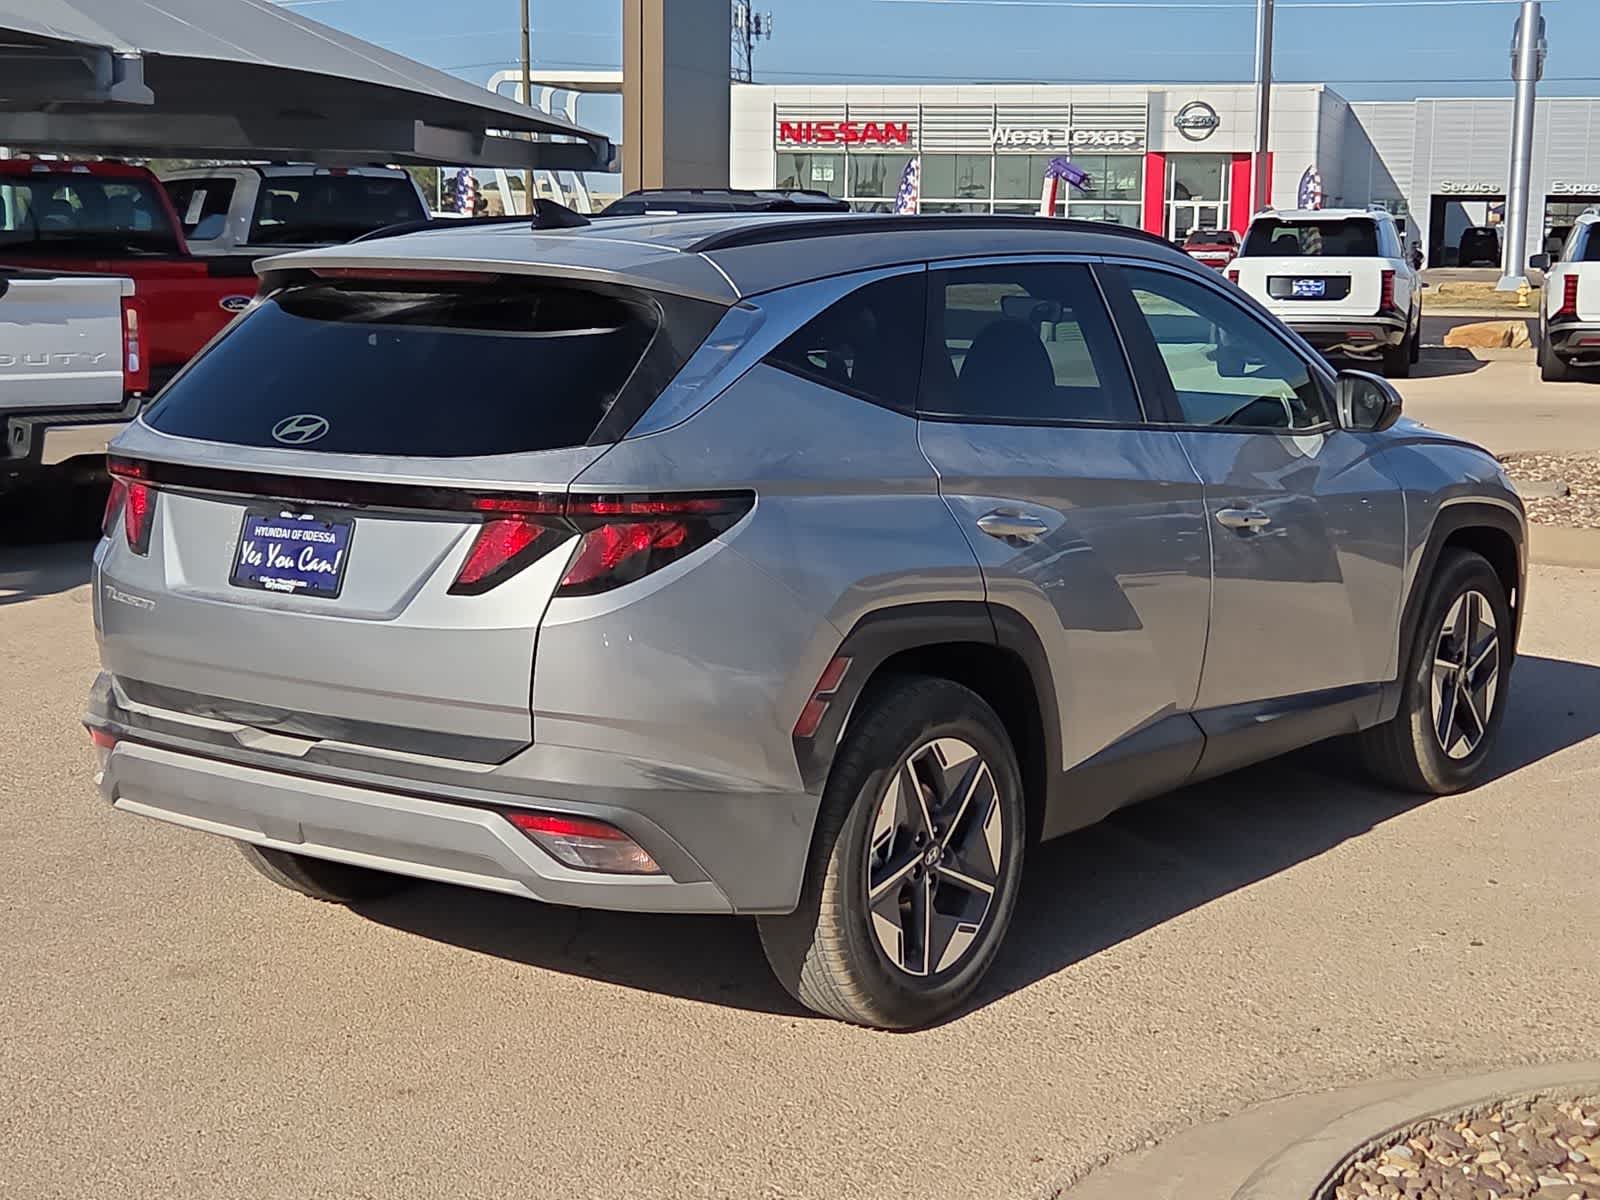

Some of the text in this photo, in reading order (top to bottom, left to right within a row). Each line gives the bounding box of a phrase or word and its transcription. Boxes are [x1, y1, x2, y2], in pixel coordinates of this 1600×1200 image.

[779, 120, 908, 145] NISSAN
[987, 127, 1136, 146] West Texas
[1440, 180, 1500, 193] Service
[1551, 180, 1600, 194] Expre
[254, 526, 336, 545] HYUNDAI OF ODESSA
[241, 540, 343, 575] Yes You Can!
